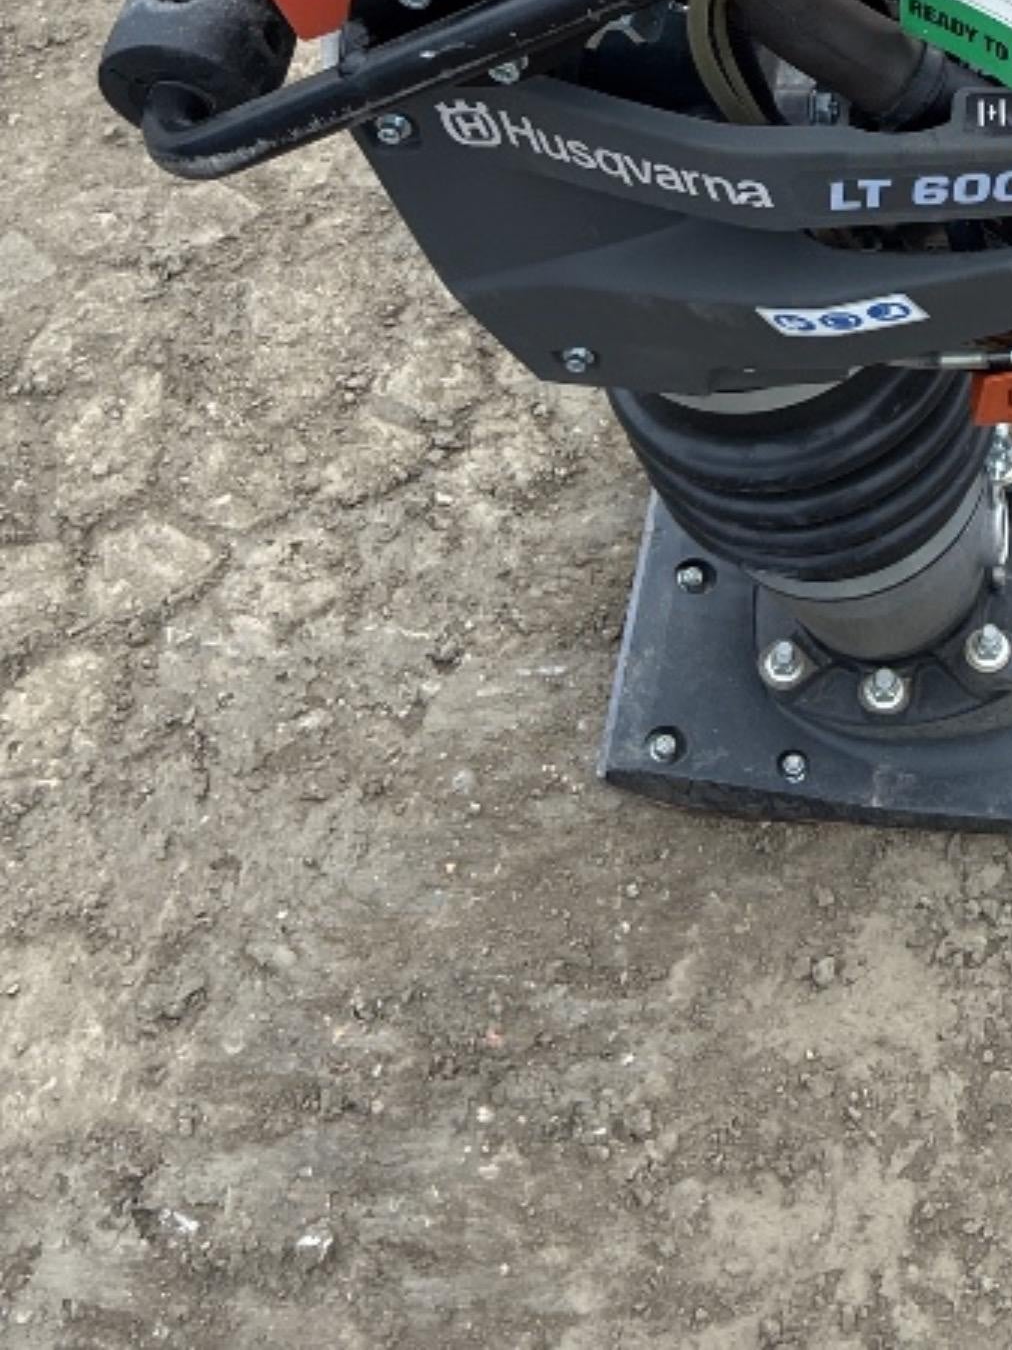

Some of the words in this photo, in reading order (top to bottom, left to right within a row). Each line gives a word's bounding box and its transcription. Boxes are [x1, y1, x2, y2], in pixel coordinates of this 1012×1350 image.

[984, 35, 1009, 61] TO
[498, 110, 775, 208] Husqvarna
[830, 178, 892, 211] LT
